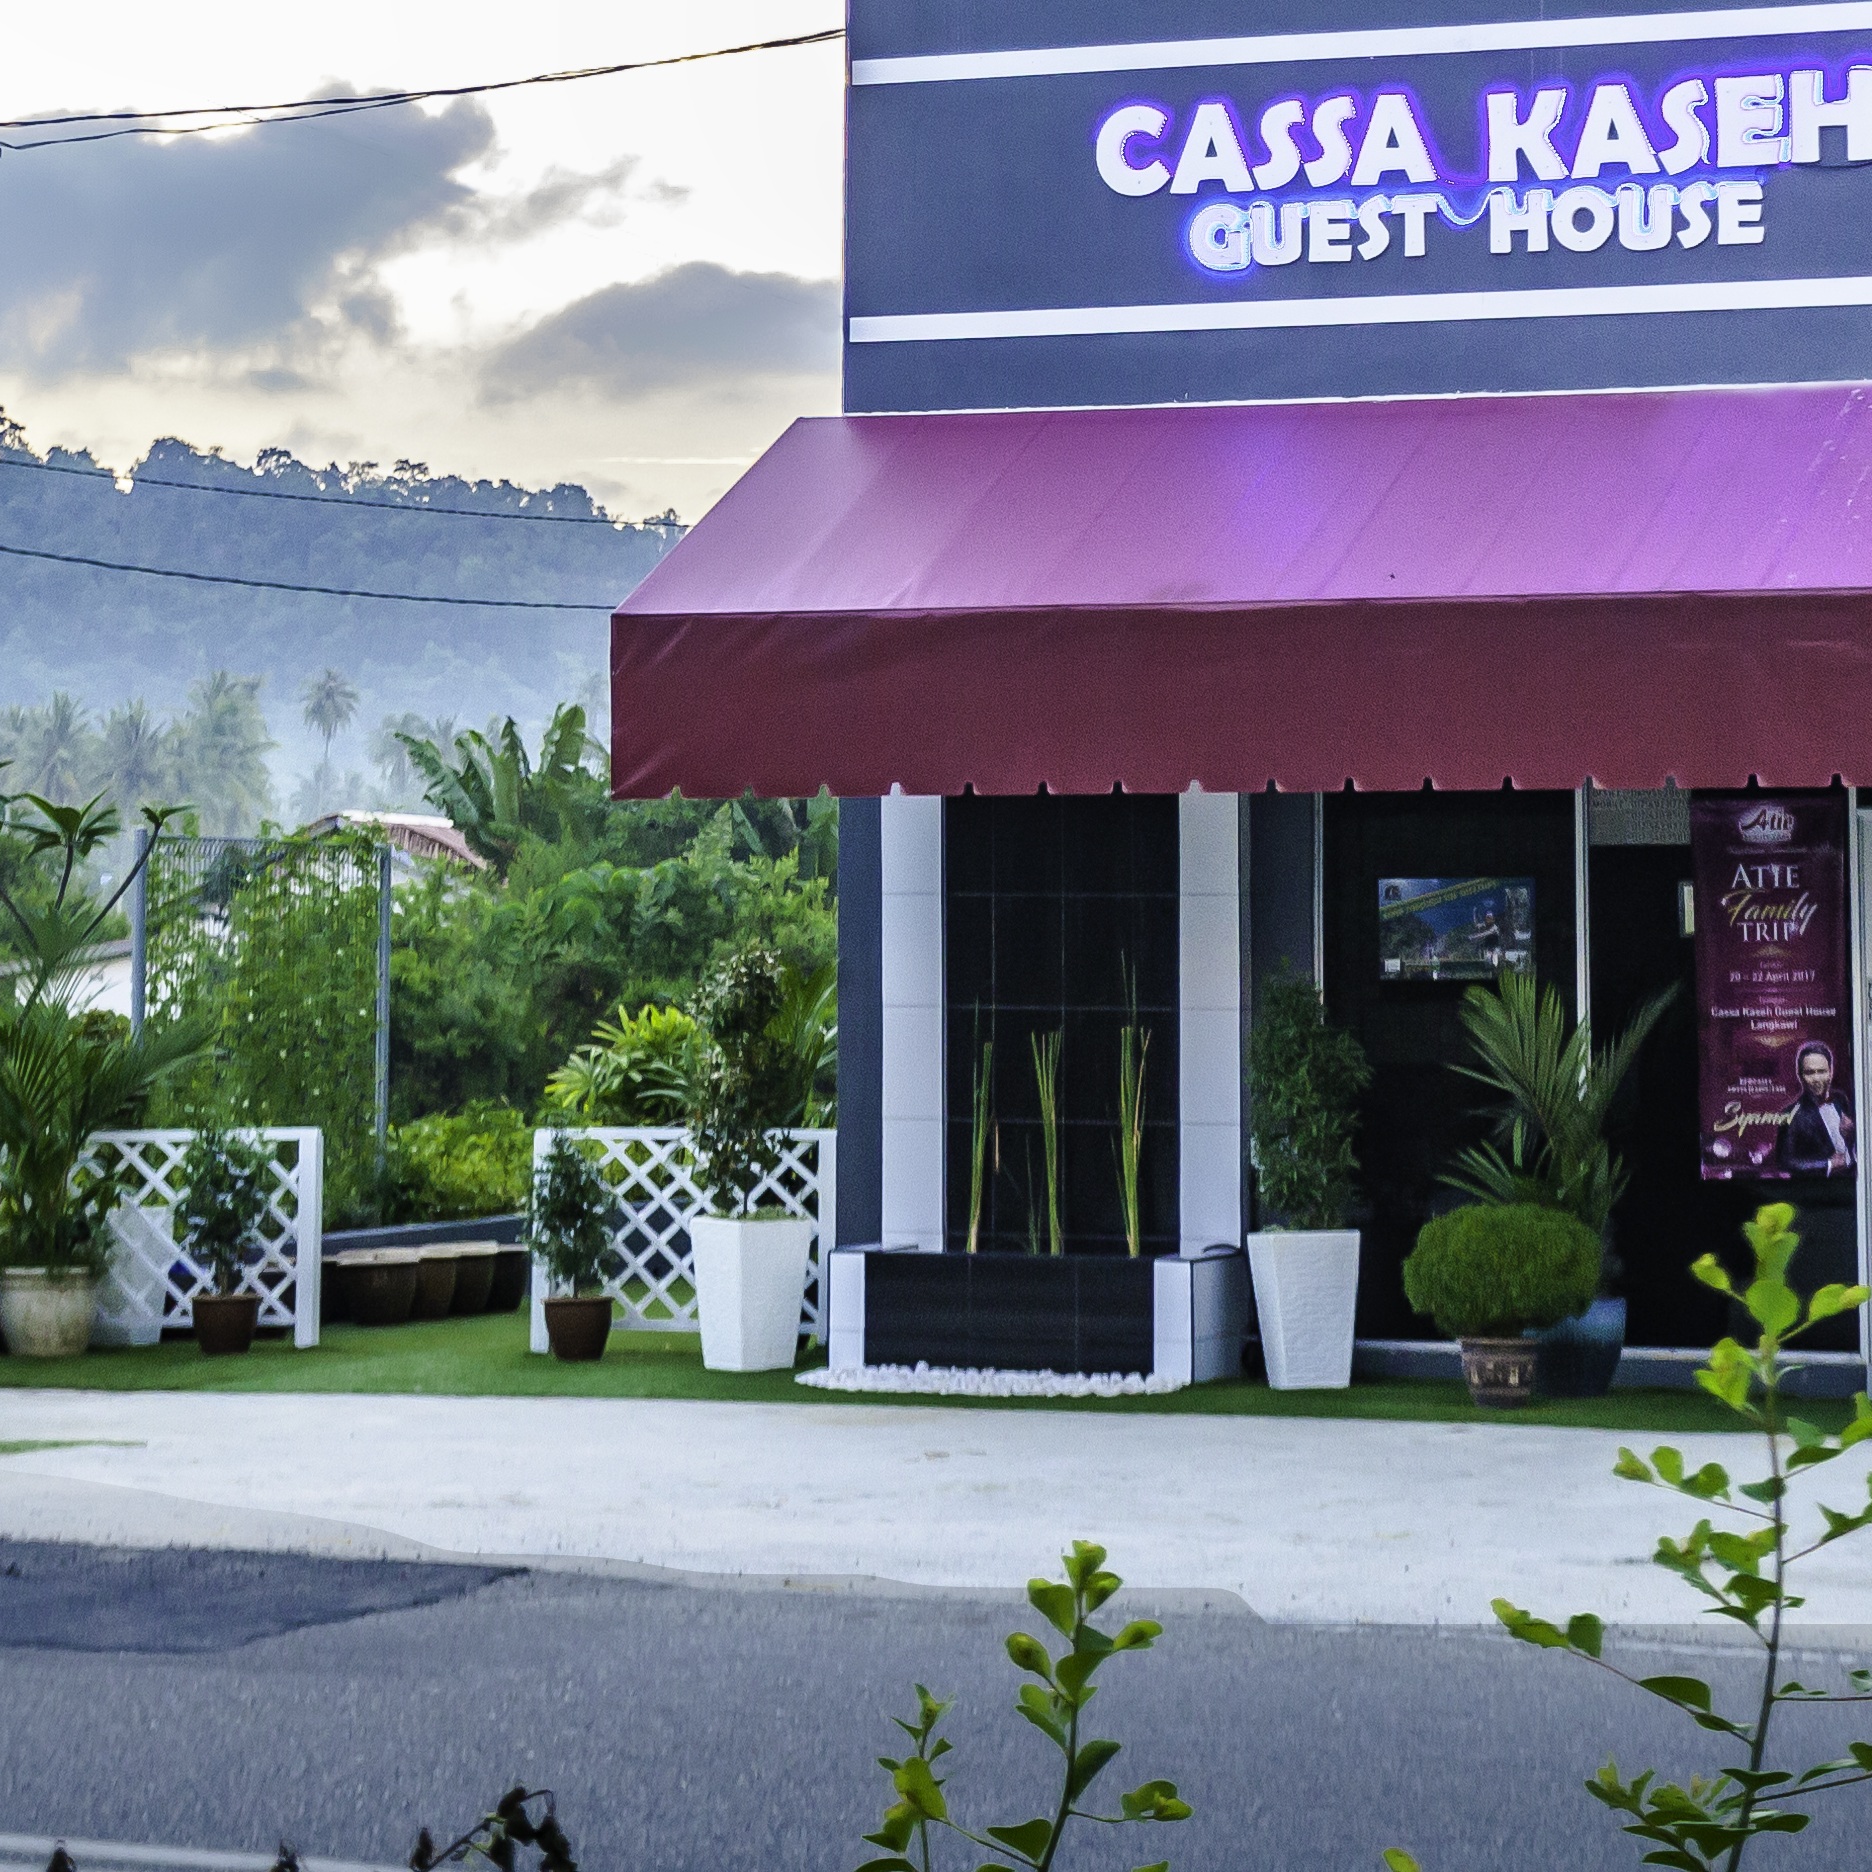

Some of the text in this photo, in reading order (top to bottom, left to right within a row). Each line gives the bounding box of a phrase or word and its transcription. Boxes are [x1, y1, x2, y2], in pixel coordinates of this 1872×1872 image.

[1096, 90, 1440, 197] CASSA
[1189, 183, 1767, 270] GUEST HOUSE
[1731, 863, 1800, 889] ATIE
[1721, 888, 1818, 936] Family
[1736, 921, 1799, 942] TRIP
